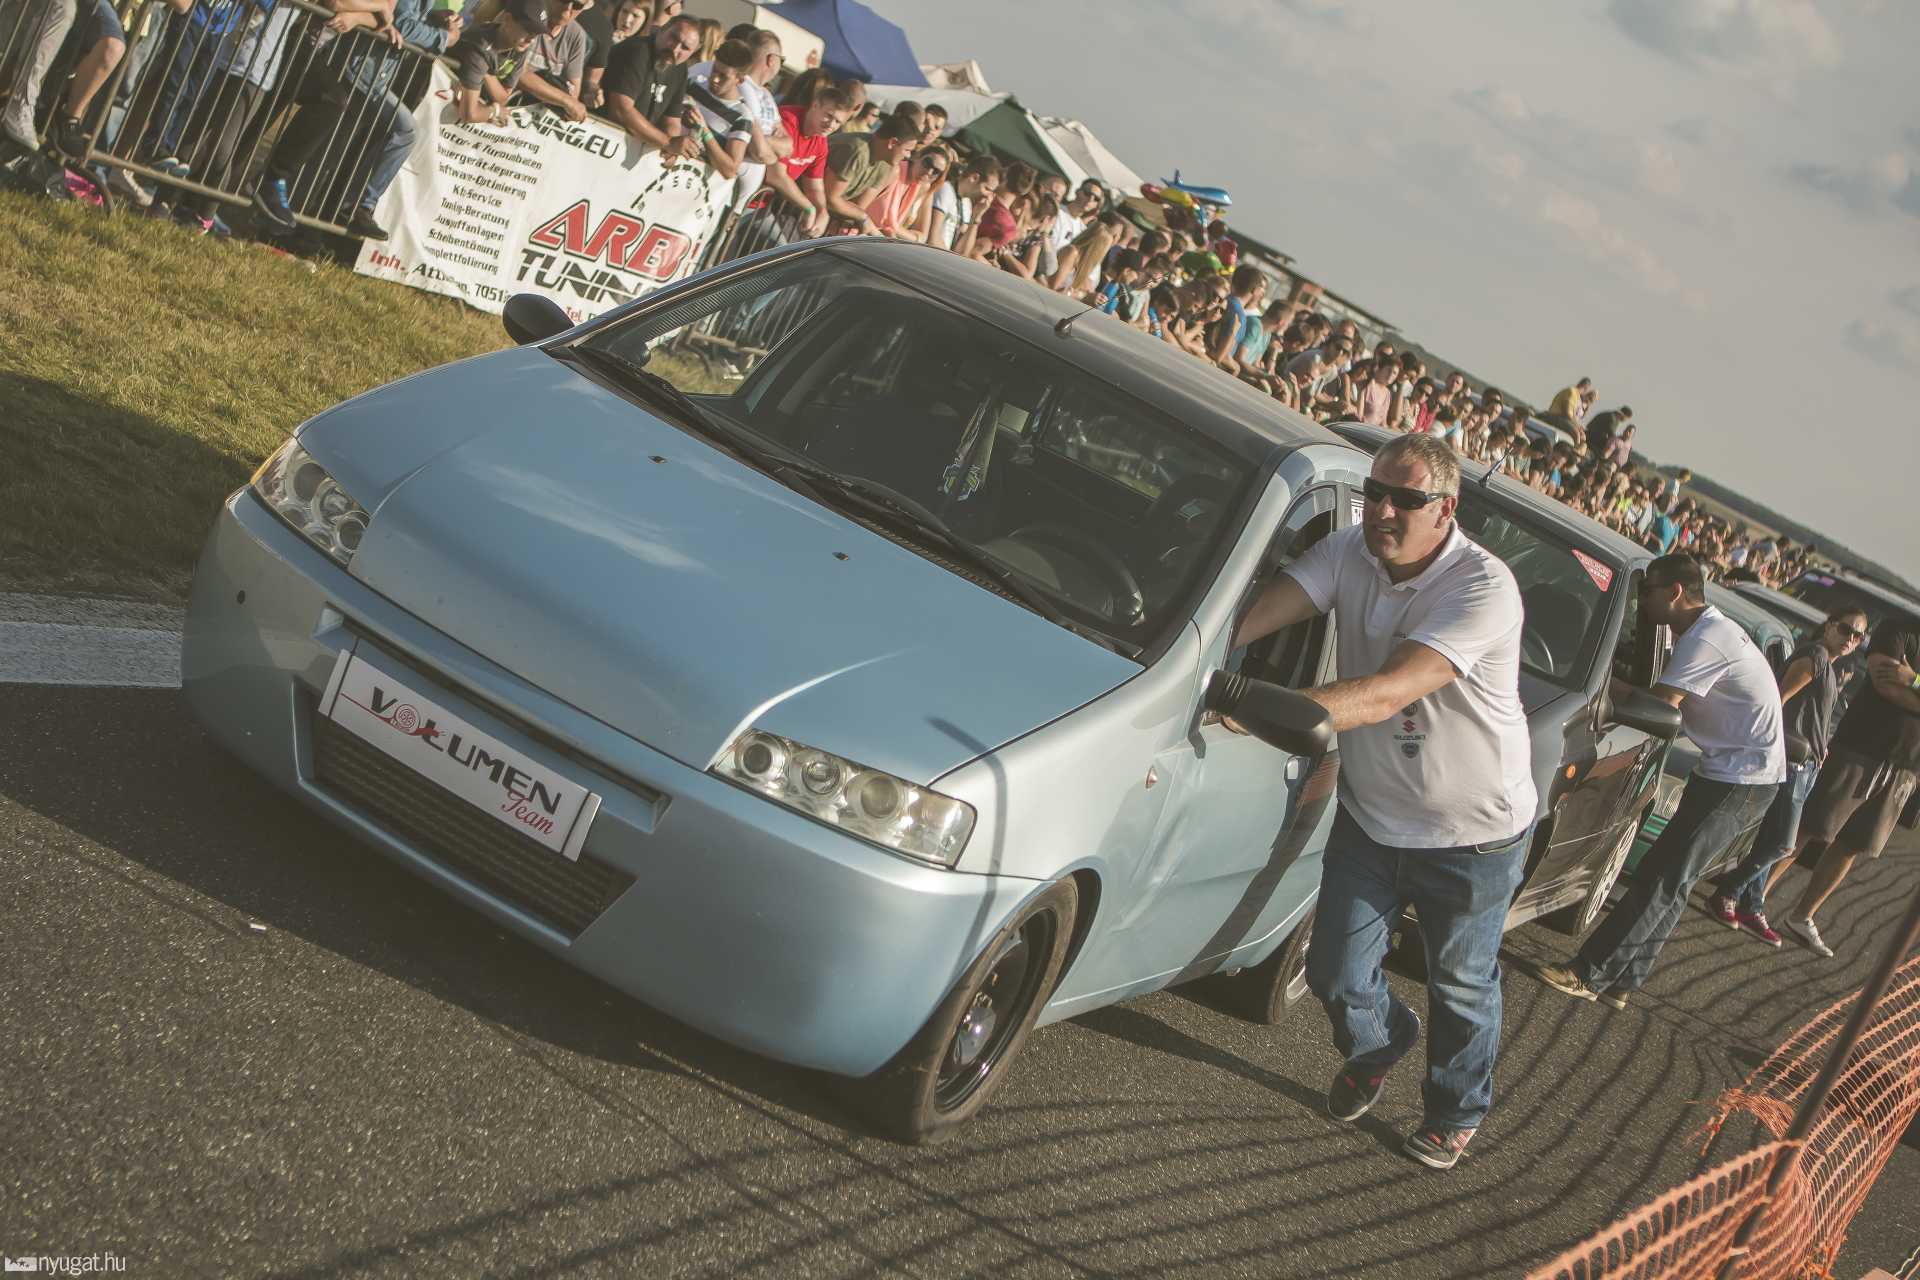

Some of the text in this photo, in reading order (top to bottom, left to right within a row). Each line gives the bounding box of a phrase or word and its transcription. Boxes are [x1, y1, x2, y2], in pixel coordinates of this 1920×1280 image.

[528, 198, 692, 284] ARB
[515, 247, 660, 306] TUNIN
[501, 787, 554, 835] Team
